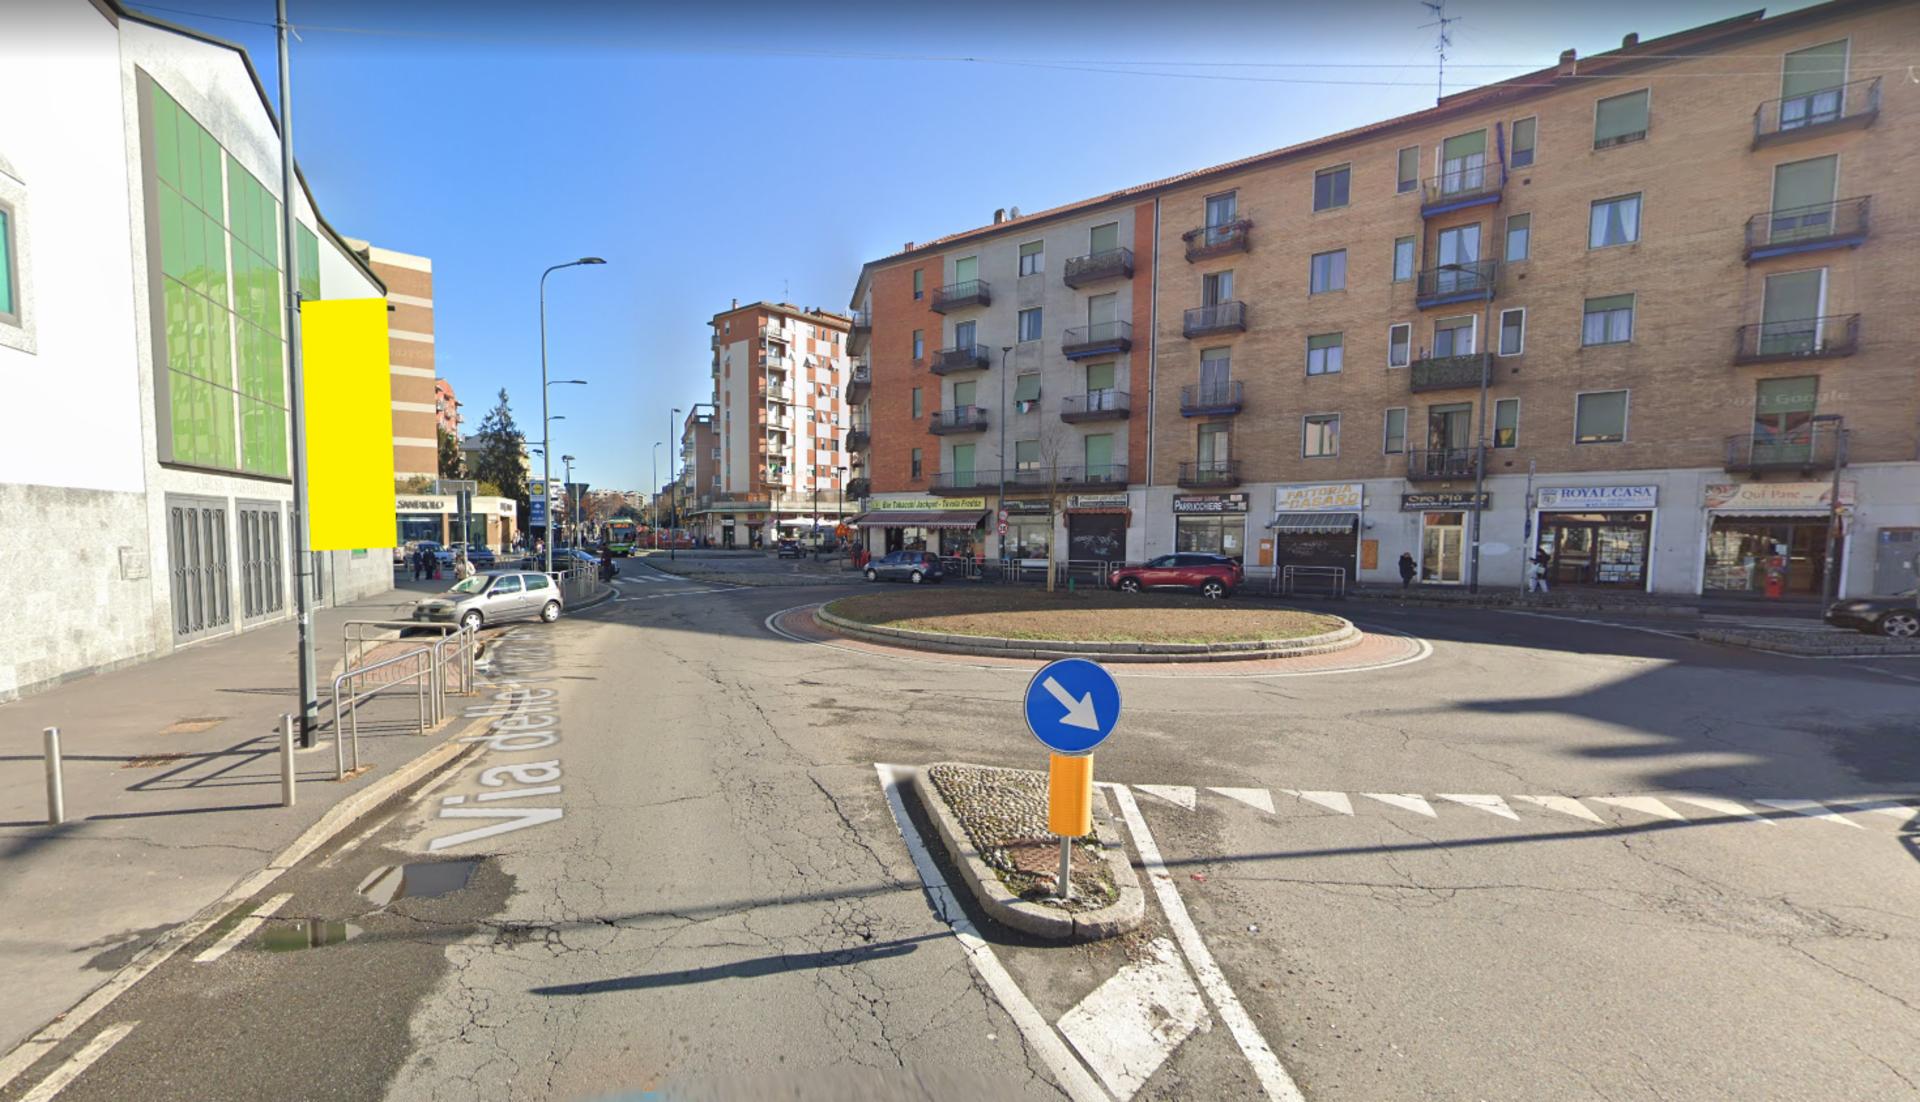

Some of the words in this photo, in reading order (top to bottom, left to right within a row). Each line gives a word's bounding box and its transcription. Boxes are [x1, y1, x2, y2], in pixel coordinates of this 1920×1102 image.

[1287, 484, 1352, 499] FATTORIA
[1561, 488, 1608, 498] ROYAL
[1612, 487, 1652, 497] CASA
[1174, 500, 1223, 511] PARRUCCHIERE
